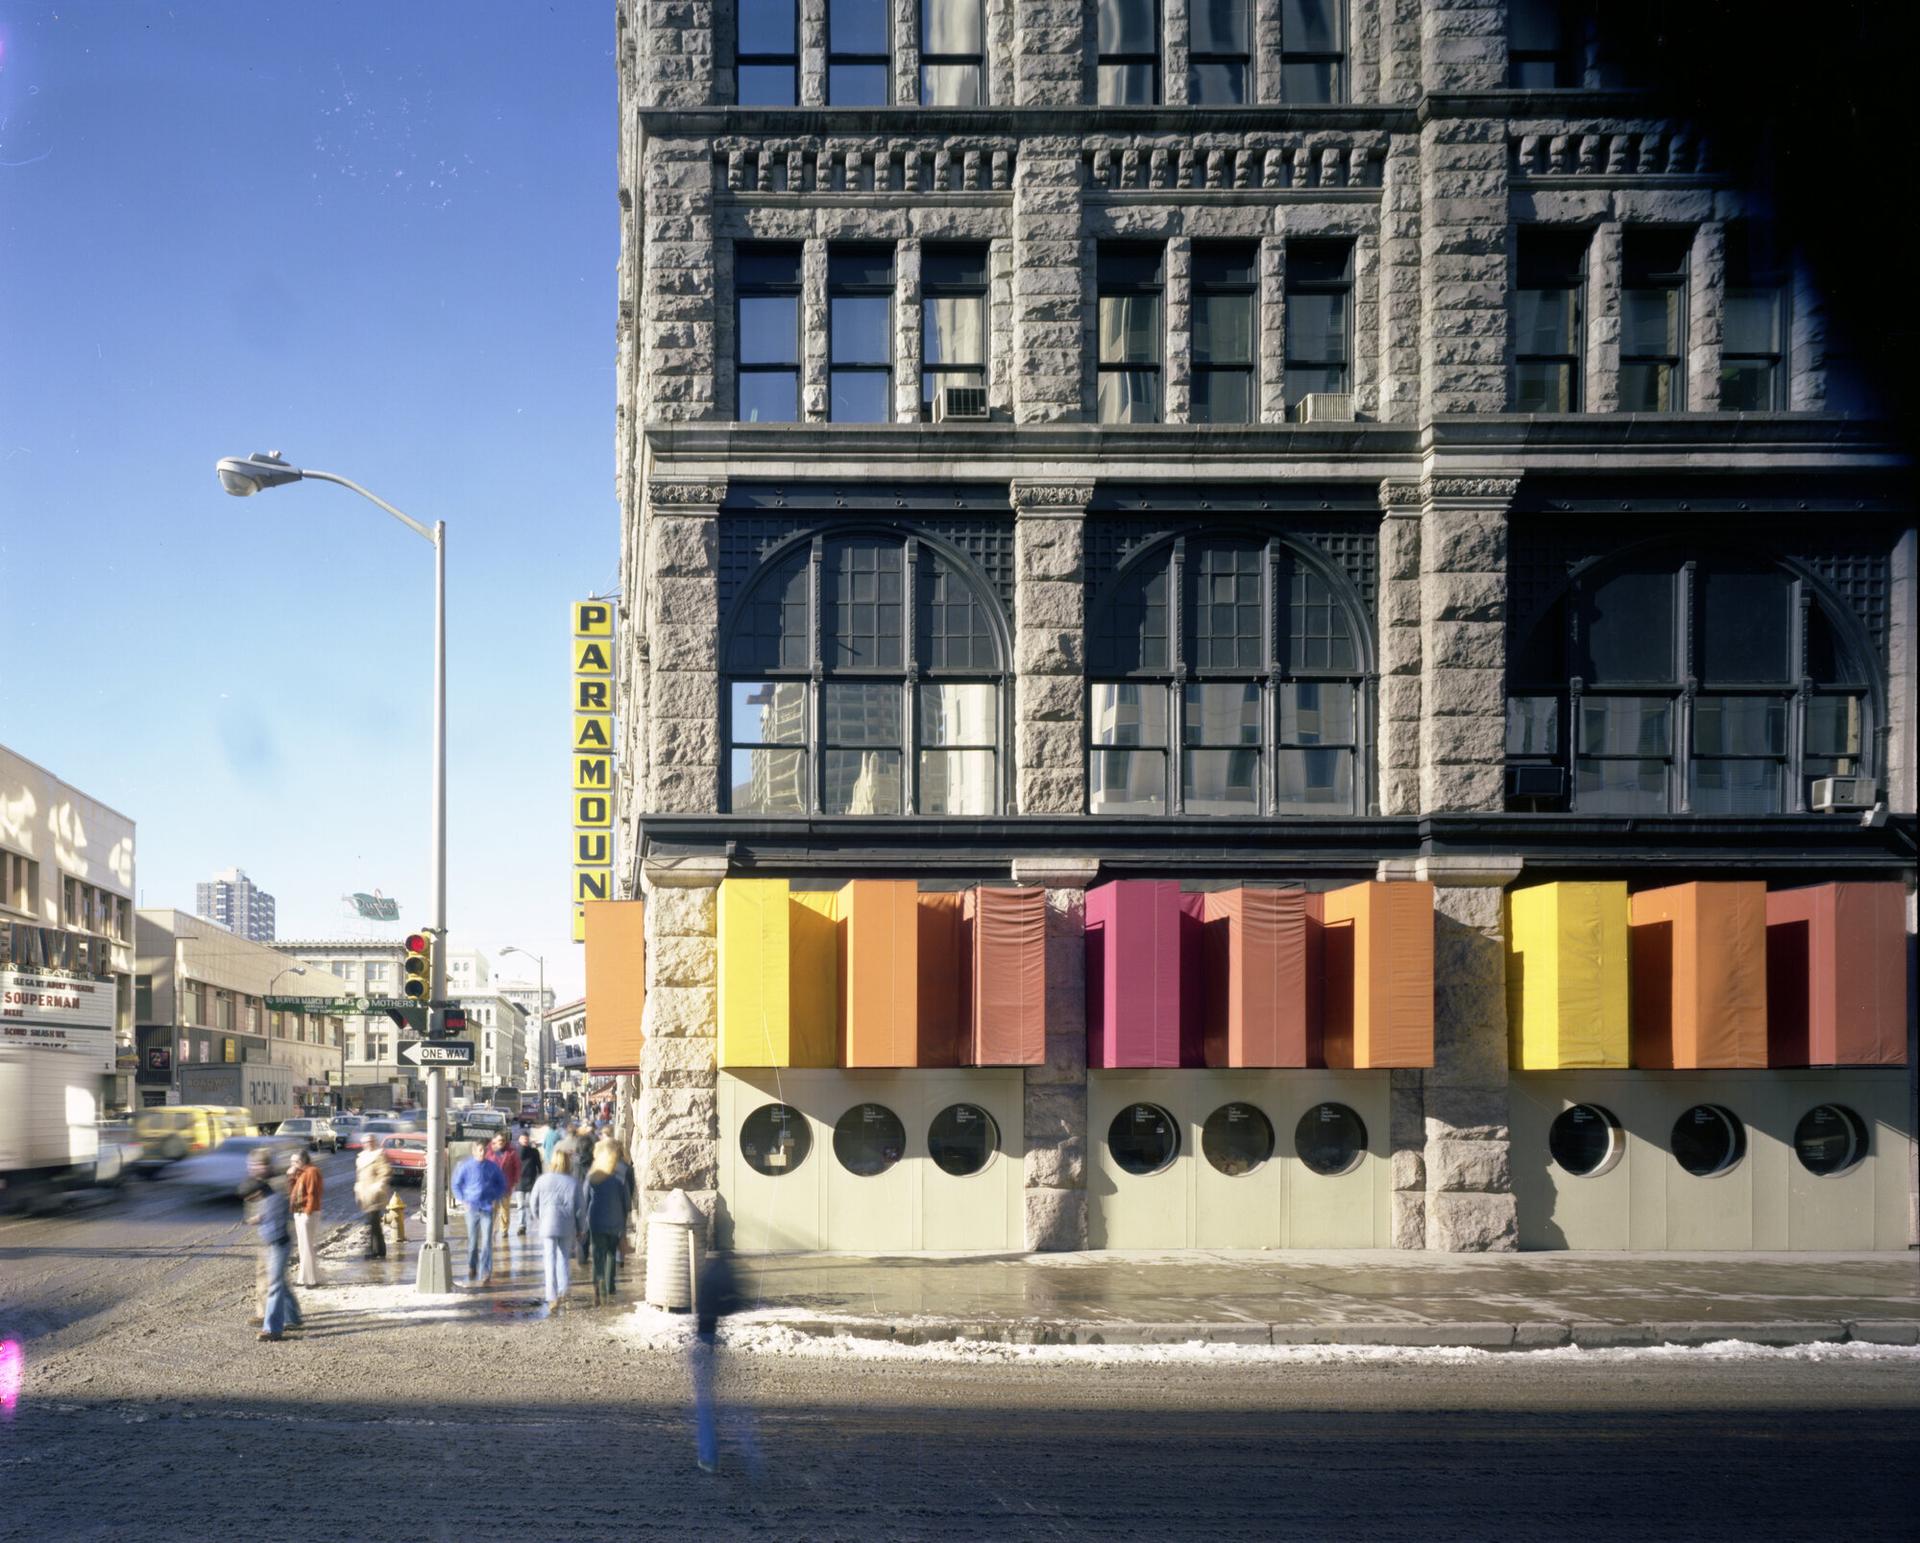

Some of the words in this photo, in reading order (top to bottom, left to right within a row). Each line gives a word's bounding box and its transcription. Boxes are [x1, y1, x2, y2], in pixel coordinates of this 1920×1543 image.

[579, 605, 608, 917] PARAMOUN
[4, 991, 80, 1010] SOUPERMAN
[371, 999, 415, 1007] MOTHERS
[421, 1048, 444, 1059] ONE
[445, 1048, 467, 1059] WAY
